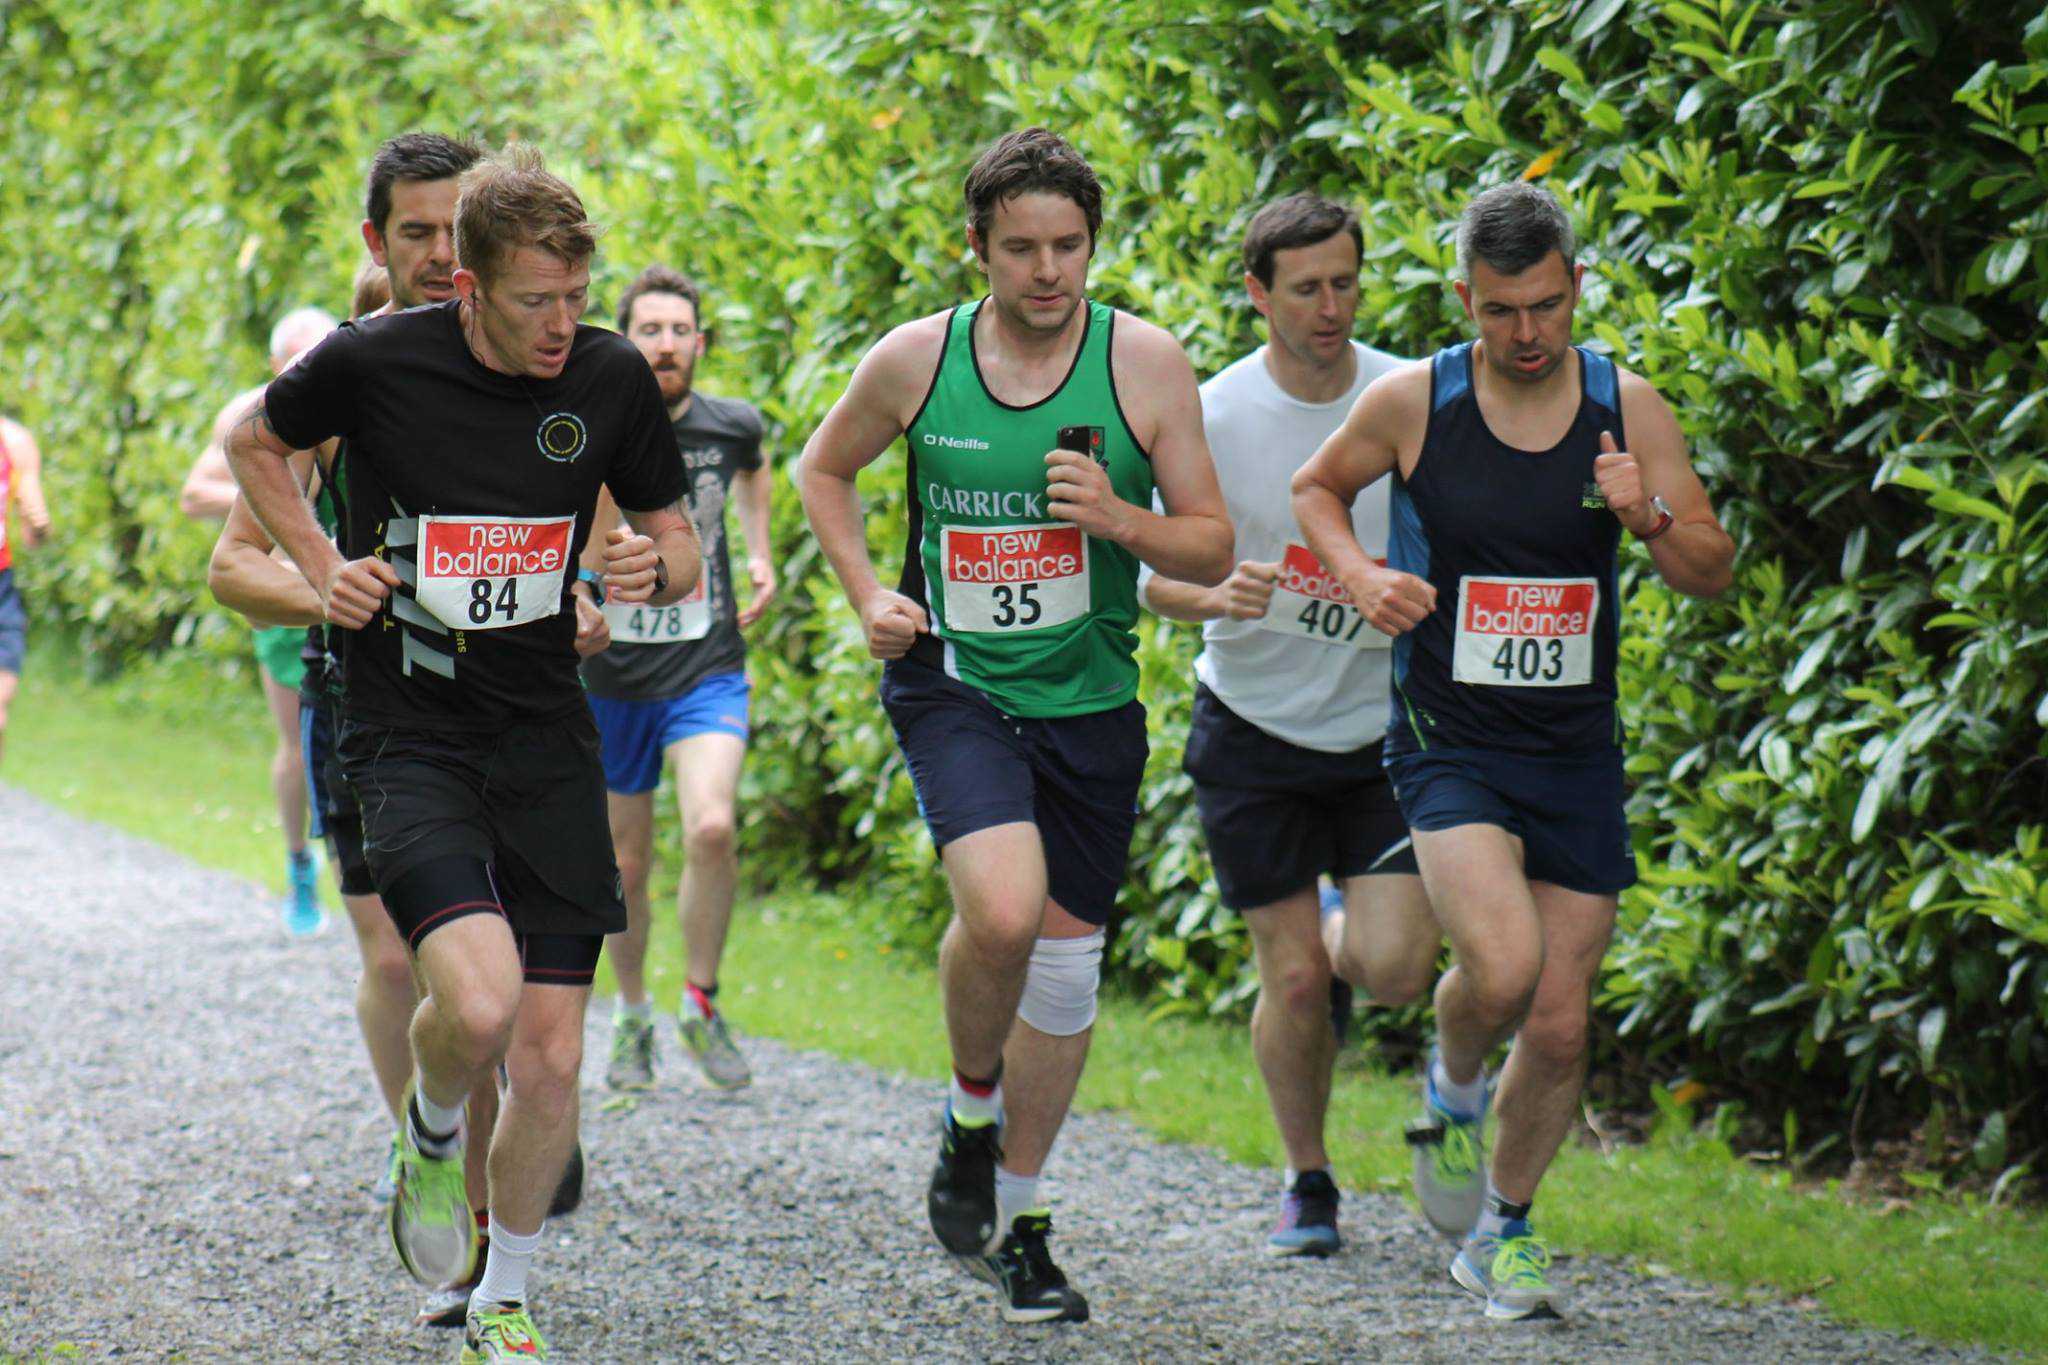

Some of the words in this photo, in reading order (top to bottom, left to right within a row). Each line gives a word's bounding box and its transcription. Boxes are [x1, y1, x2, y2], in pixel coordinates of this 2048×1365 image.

[928, 482, 1043, 518] CARRICK
[468, 524, 532, 548] new
[982, 532, 1042, 555] new
[432, 545, 560, 576] balance
[954, 553, 1076, 581] balance
[467, 577, 519, 623] 84
[991, 582, 1042, 628] 35
[1505, 586, 1565, 608] new
[628, 606, 683, 637] 478
[1471, 604, 1584, 634] balance
[1492, 637, 1564, 682] 403
